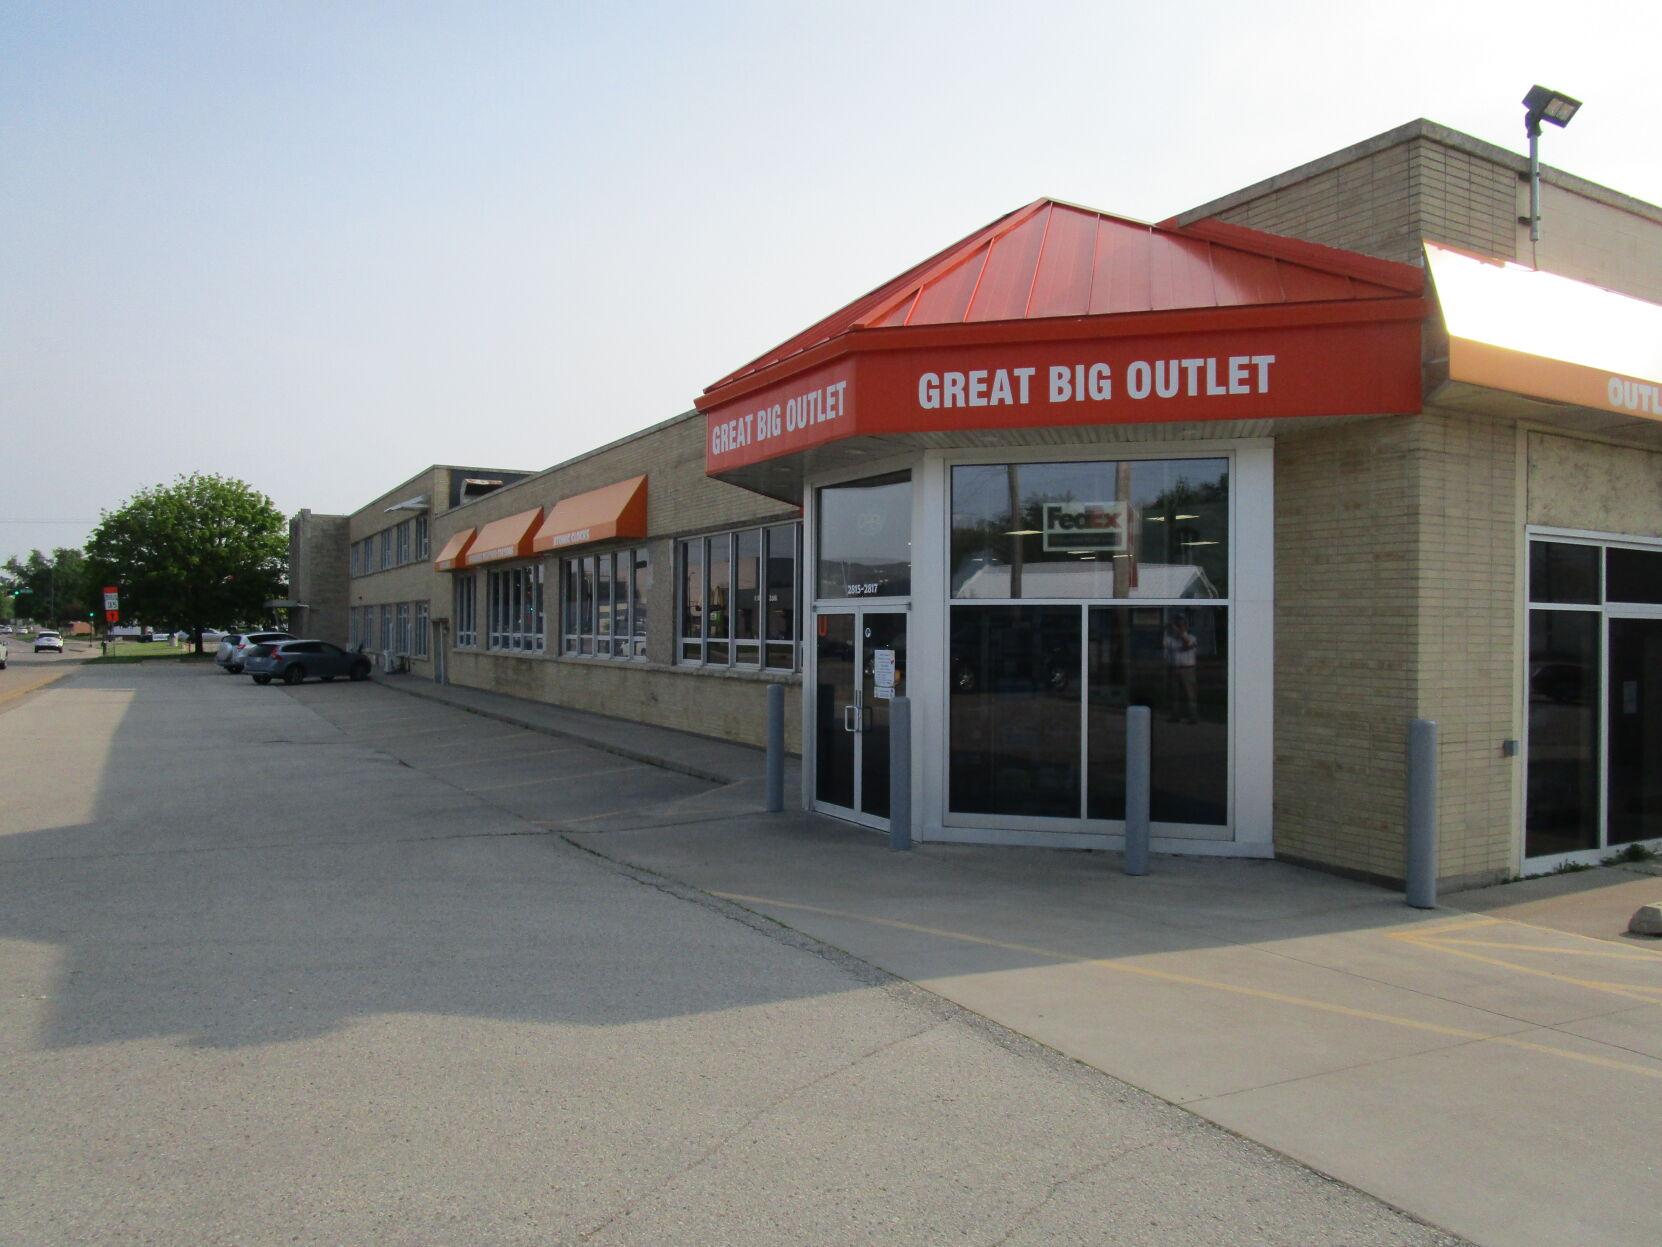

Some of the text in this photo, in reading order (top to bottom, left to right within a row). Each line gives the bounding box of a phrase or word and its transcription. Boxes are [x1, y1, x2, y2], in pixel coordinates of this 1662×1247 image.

[918, 355, 1276, 409] GREAT BIG OUTLET
[712, 380, 847, 455] GREAT BIG OUTLET
[1046, 505, 1122, 530] FedEx
